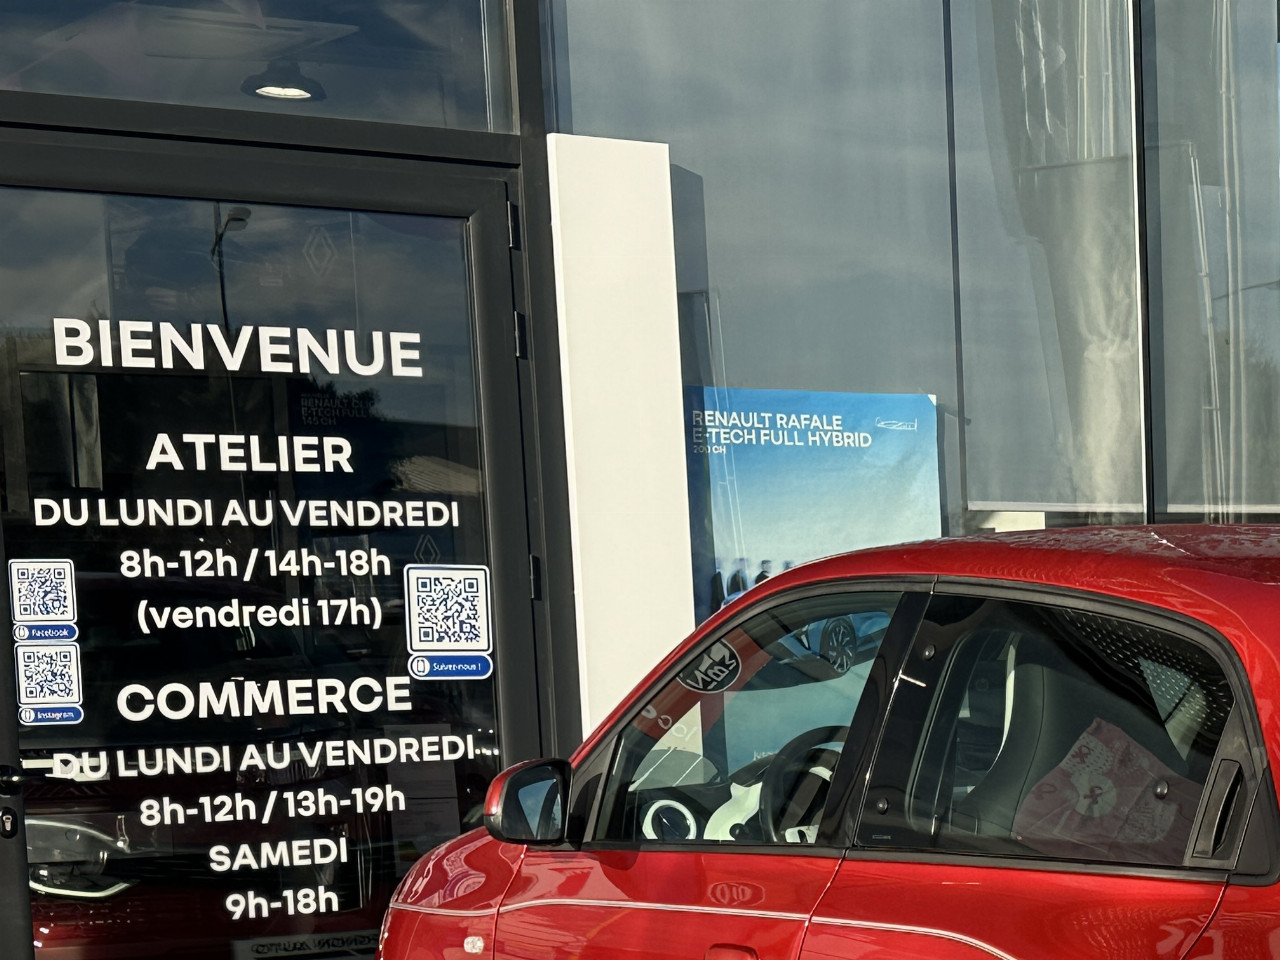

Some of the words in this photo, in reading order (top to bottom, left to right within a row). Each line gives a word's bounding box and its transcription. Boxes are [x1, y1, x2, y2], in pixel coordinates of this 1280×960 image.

[54, 318, 423, 377] BIENVENUE
[693, 410, 772, 428] RENAULT
[776, 414, 843, 430] RAFALE
[146, 434, 354, 472] ATELIER
[761, 430, 804, 446] FULL
[808, 431, 873, 448] HYBRID
[34, 499, 89, 526] DU
[99, 499, 213, 526] LUNDI
[222, 500, 274, 526] AU
[280, 500, 459, 527] VENDREDI
[120, 549, 238, 578] 8h-12h
[265, 548, 391, 577] 14h-18h
[138, 598, 311, 634] (vendredi
[317, 597, 382, 630] 17h)
[117, 676, 412, 721] COMMERCE
[53, 751, 108, 780] DU
[117, 746, 231, 777] LUNDI
[240, 743, 291, 771] AU
[298, 734, 475, 768] VENDREDI
[140, 792, 257, 827] 8h-12h
[283, 785, 406, 818] 13h-19h
[209, 837, 348, 872] SAMEDI
[226, 886, 339, 920] 9h-18h
